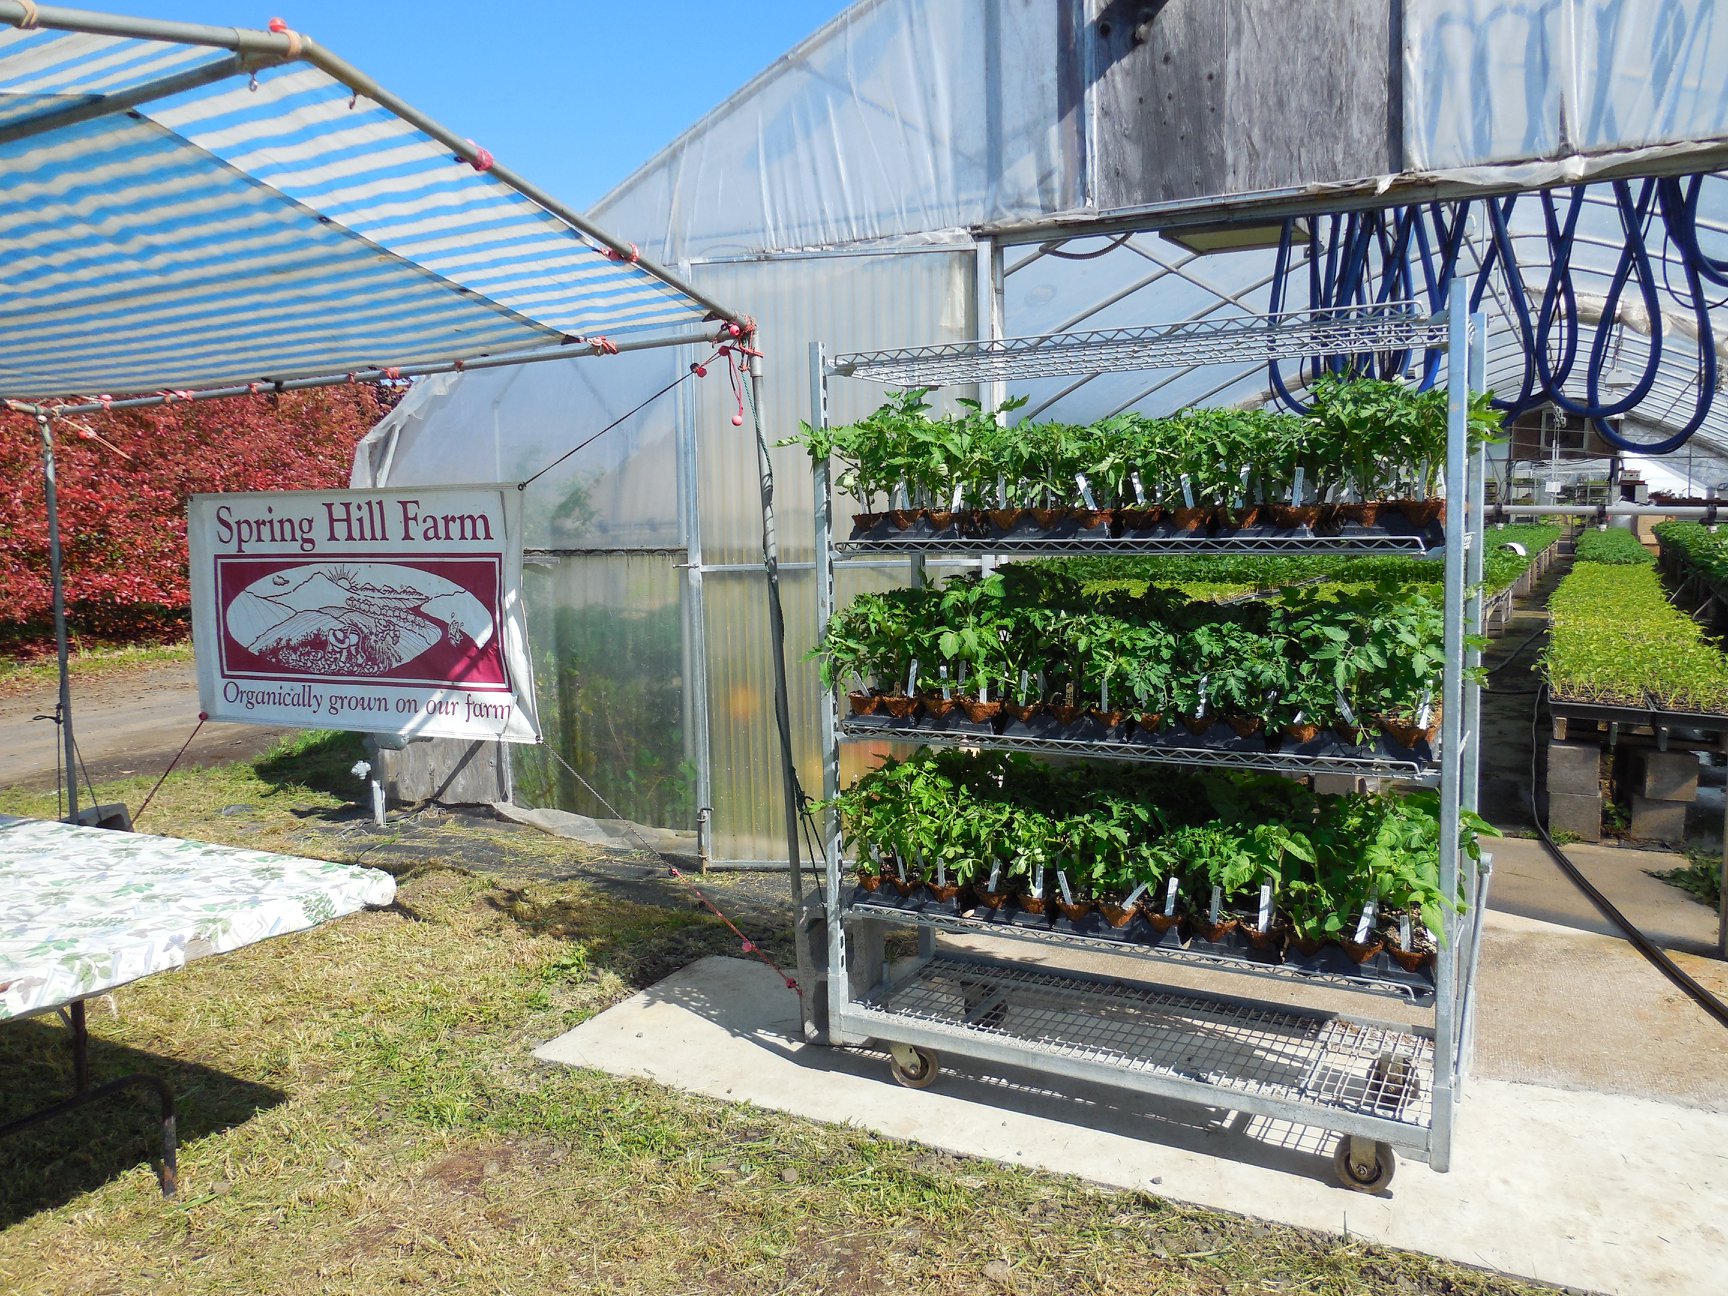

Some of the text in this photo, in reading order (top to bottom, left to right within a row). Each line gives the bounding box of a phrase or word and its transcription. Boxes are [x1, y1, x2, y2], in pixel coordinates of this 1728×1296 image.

[215, 500, 494, 553] Spring Hill Farm
[223, 681, 511, 722] Organically grown on our farm
